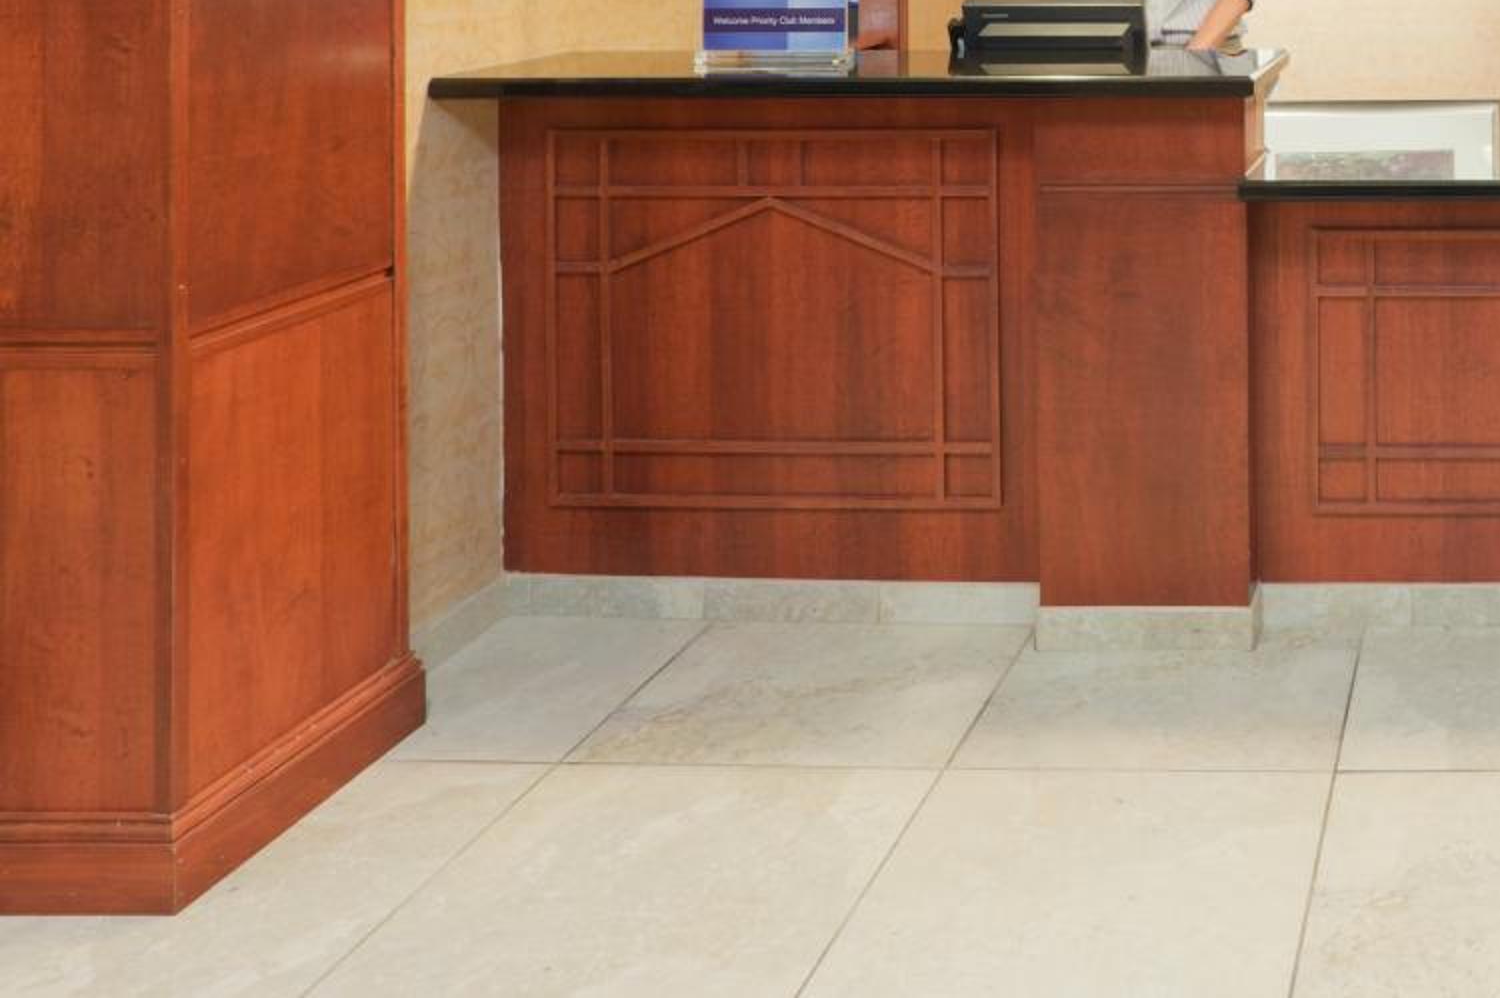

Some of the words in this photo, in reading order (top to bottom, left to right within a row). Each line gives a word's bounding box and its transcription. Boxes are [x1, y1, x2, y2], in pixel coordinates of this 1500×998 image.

[713, 16, 749, 25] Welcome
[751, 15, 777, 26] Priority
[779, 15, 797, 25] Club
[799, 16, 835, 25] Members
